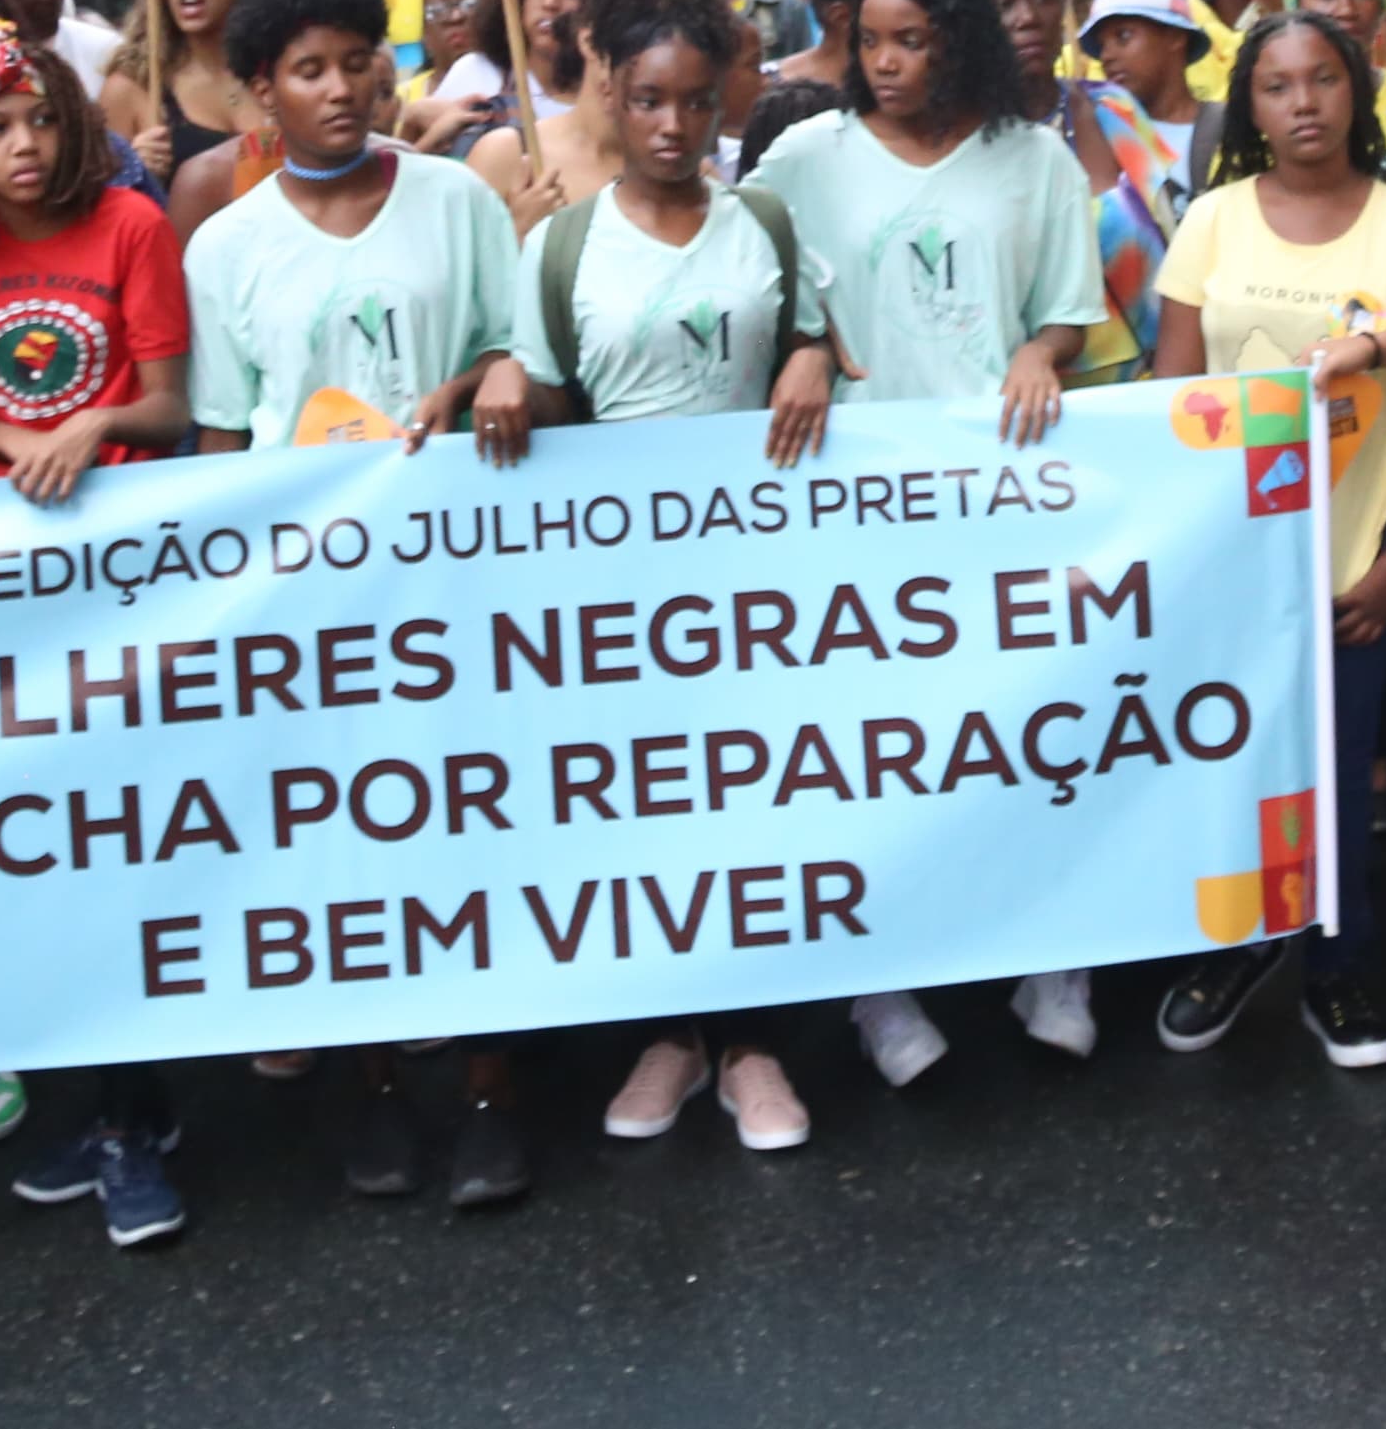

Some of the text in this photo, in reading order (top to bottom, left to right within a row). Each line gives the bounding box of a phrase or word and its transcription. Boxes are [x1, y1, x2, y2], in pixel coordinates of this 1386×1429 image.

[270, 519, 370, 573] DO
[392, 495, 630, 564] JULHO
[651, 482, 788, 541] DAS
[809, 460, 1076, 531] PRETAS
[491, 576, 958, 692] NEGRAS
[994, 561, 1152, 650] EM
[271, 752, 513, 848] POR
[548, 673, 1253, 824] REPARAÇÃO
[141, 861, 870, 998] E BEM VIVER
